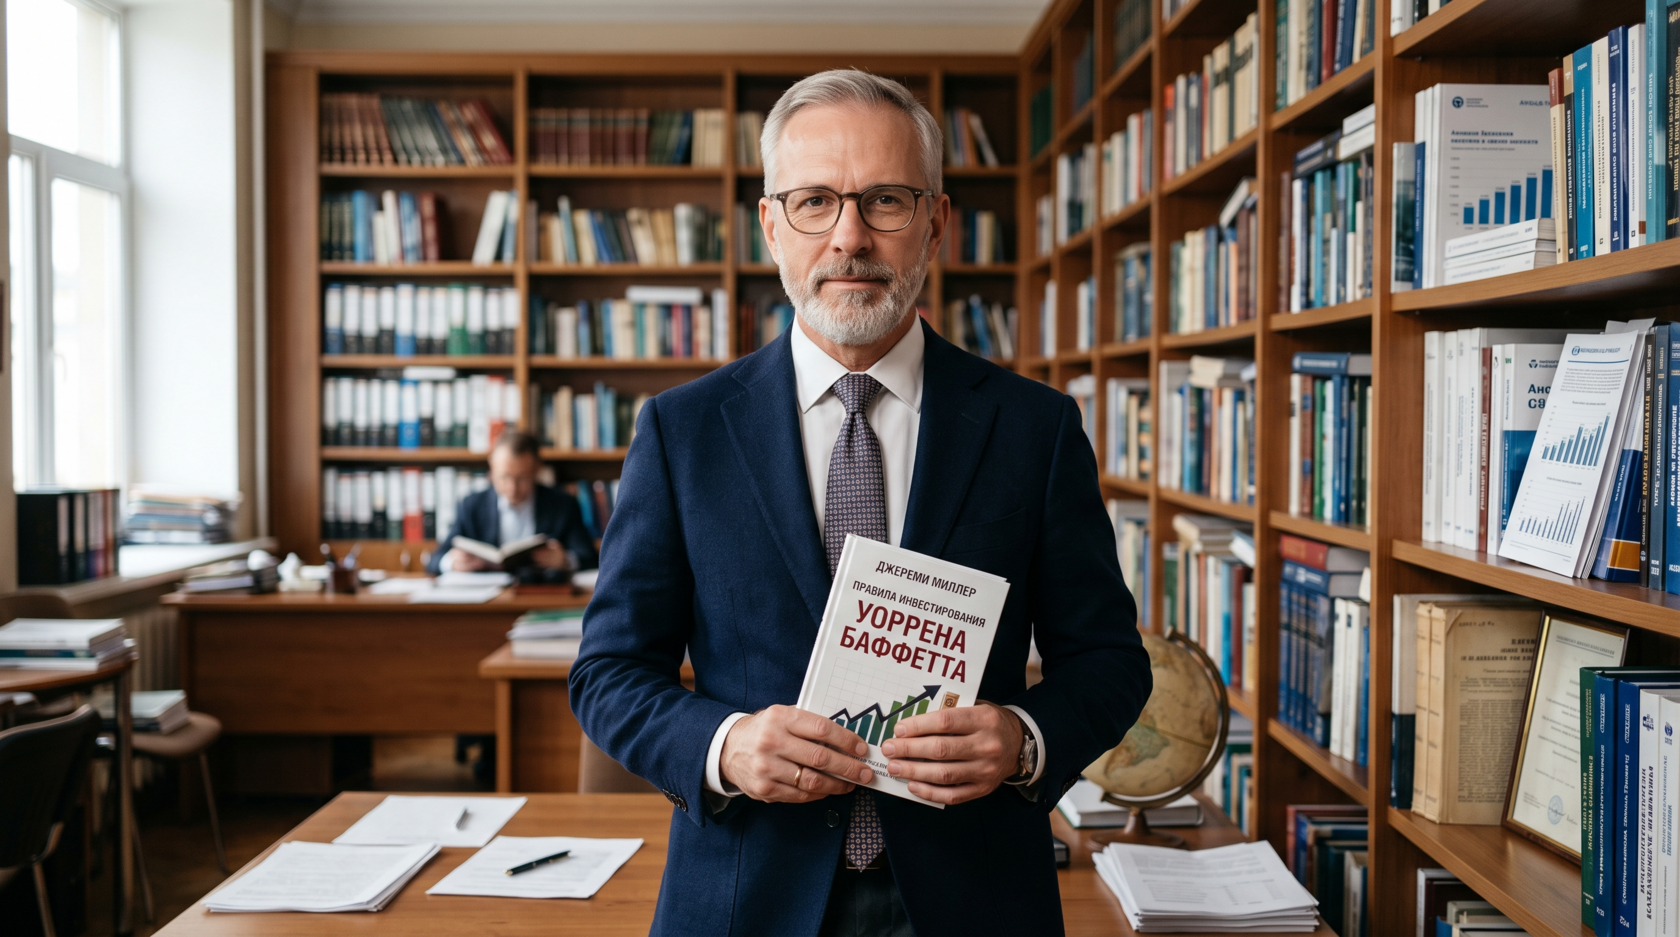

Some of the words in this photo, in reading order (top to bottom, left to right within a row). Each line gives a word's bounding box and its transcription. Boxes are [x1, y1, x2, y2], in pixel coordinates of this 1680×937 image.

[852, 580, 897, 601] ПРАВИЛА
[898, 594, 986, 627] ИНВЕСТИРОВАНИЯ
[875, 560, 930, 585] ДЖЕРЕМИ
[931, 577, 977, 598] МИЛЛЕР
[856, 599, 966, 654] УОРРЕНА
[840, 625, 966, 683] БАФФЕТТА
